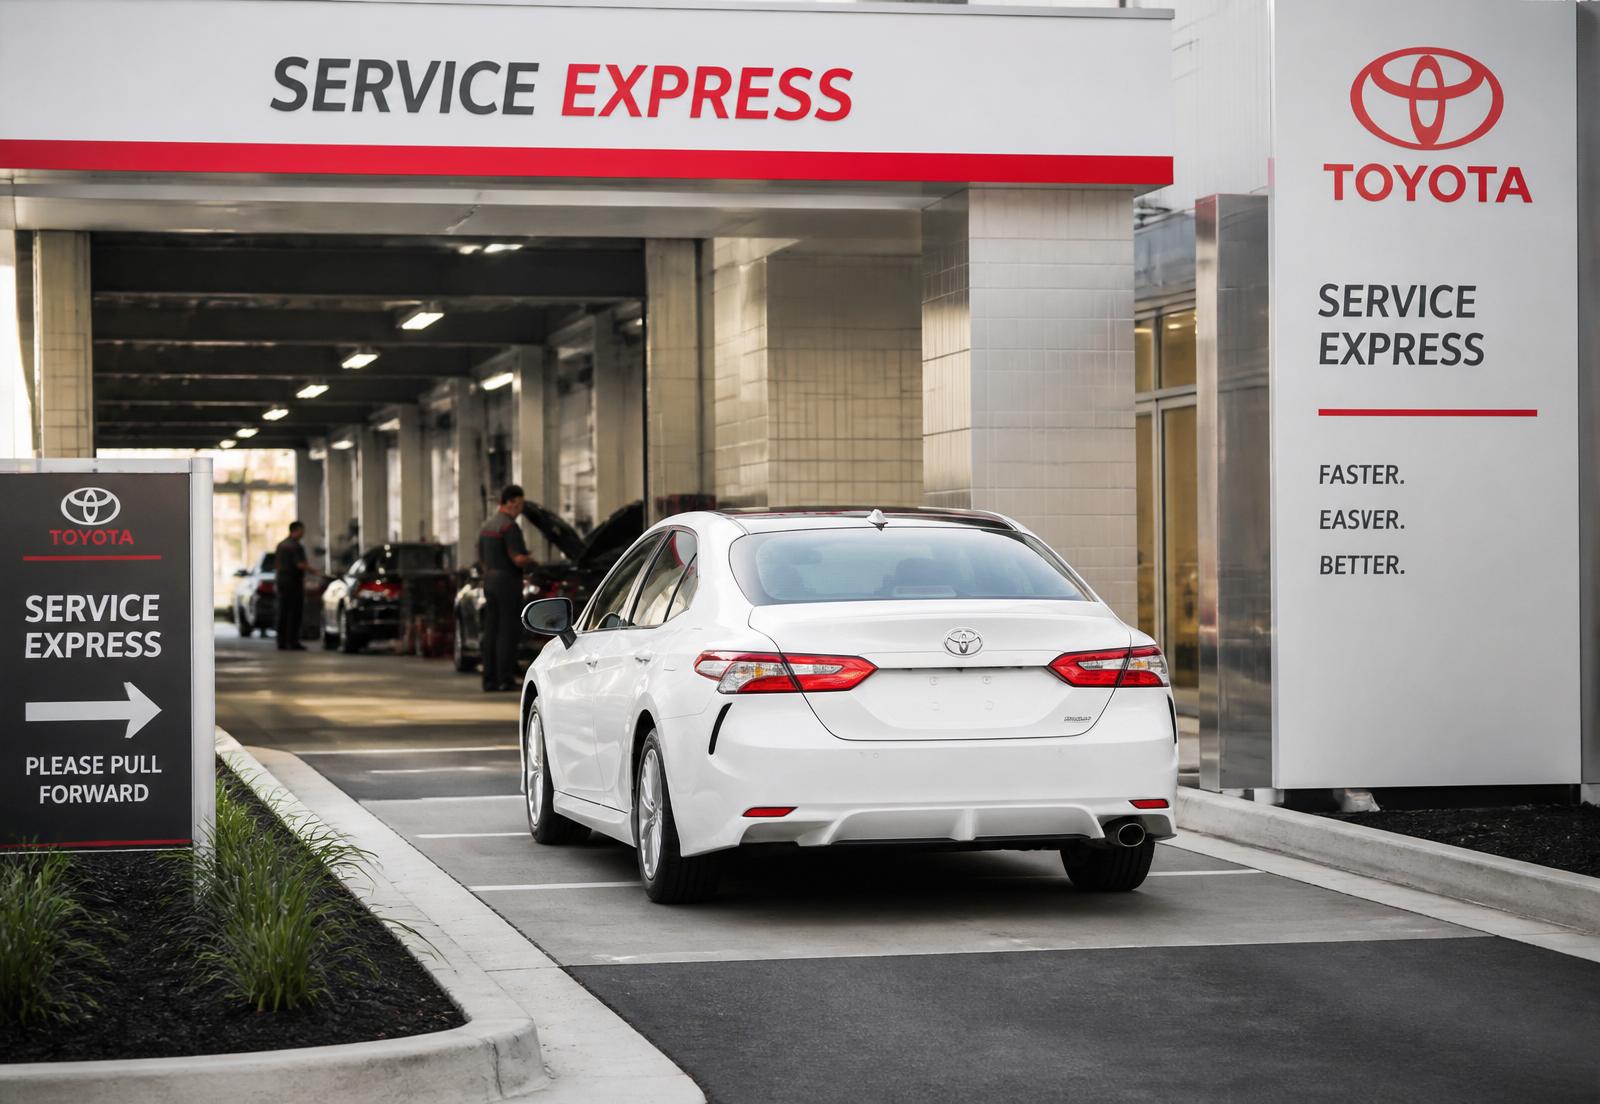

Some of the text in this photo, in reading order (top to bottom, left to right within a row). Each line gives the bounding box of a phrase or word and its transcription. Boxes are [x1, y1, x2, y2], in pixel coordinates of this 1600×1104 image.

[270, 56, 854, 122] SERVICE EXPRESS
[1323, 163, 1534, 204] TOYOTA
[1318, 283, 1477, 319] SERVICE
[1319, 332, 1485, 367] EXPRESS
[1319, 464, 1405, 485] FASTER.
[1319, 509, 1405, 530] EASVER.
[49, 529, 134, 546] TOYOTA
[1319, 554, 1405, 575] BETTER.
[25, 594, 160, 623] SERVICE
[25, 631, 162, 659] EXPRESS
[25, 755, 162, 776] PLEASE PULL
[39, 783, 149, 804] FORWARD
